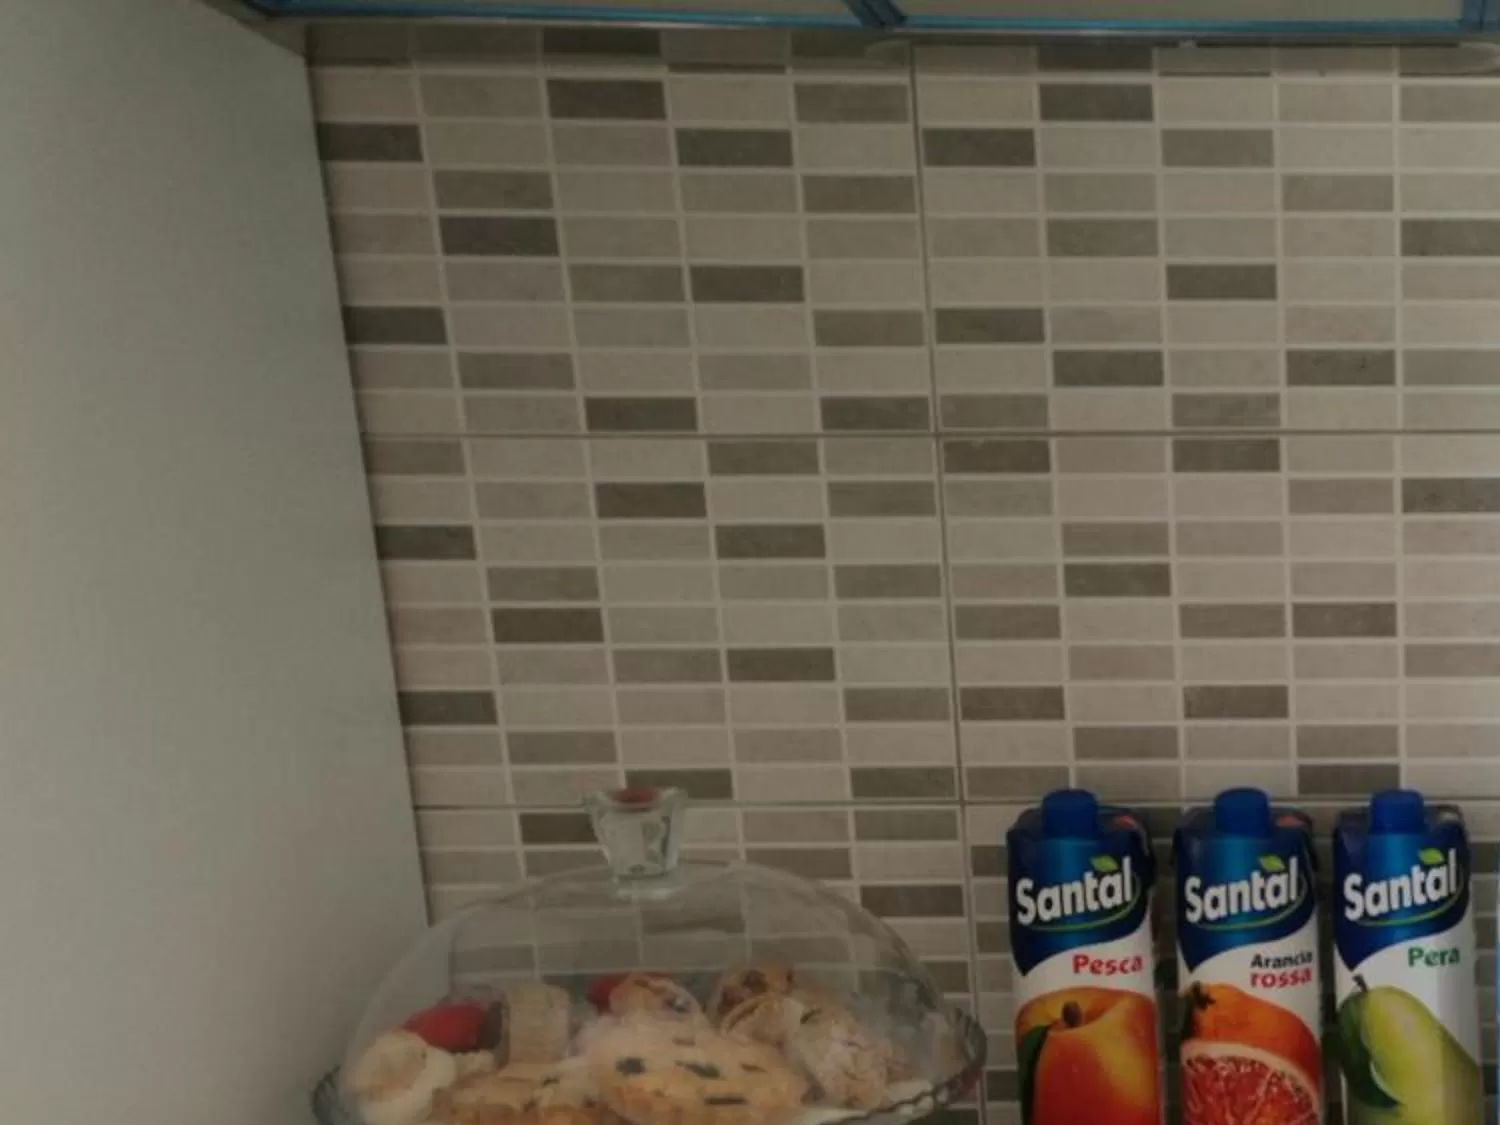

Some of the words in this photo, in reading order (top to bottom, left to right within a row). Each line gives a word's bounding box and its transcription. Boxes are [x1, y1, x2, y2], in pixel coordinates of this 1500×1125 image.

[1072, 954, 1144, 975] Pesca
[1250, 952, 1314, 970] Arancia
[1408, 946, 1461, 968] Pera
[1250, 967, 1313, 989] rossa
